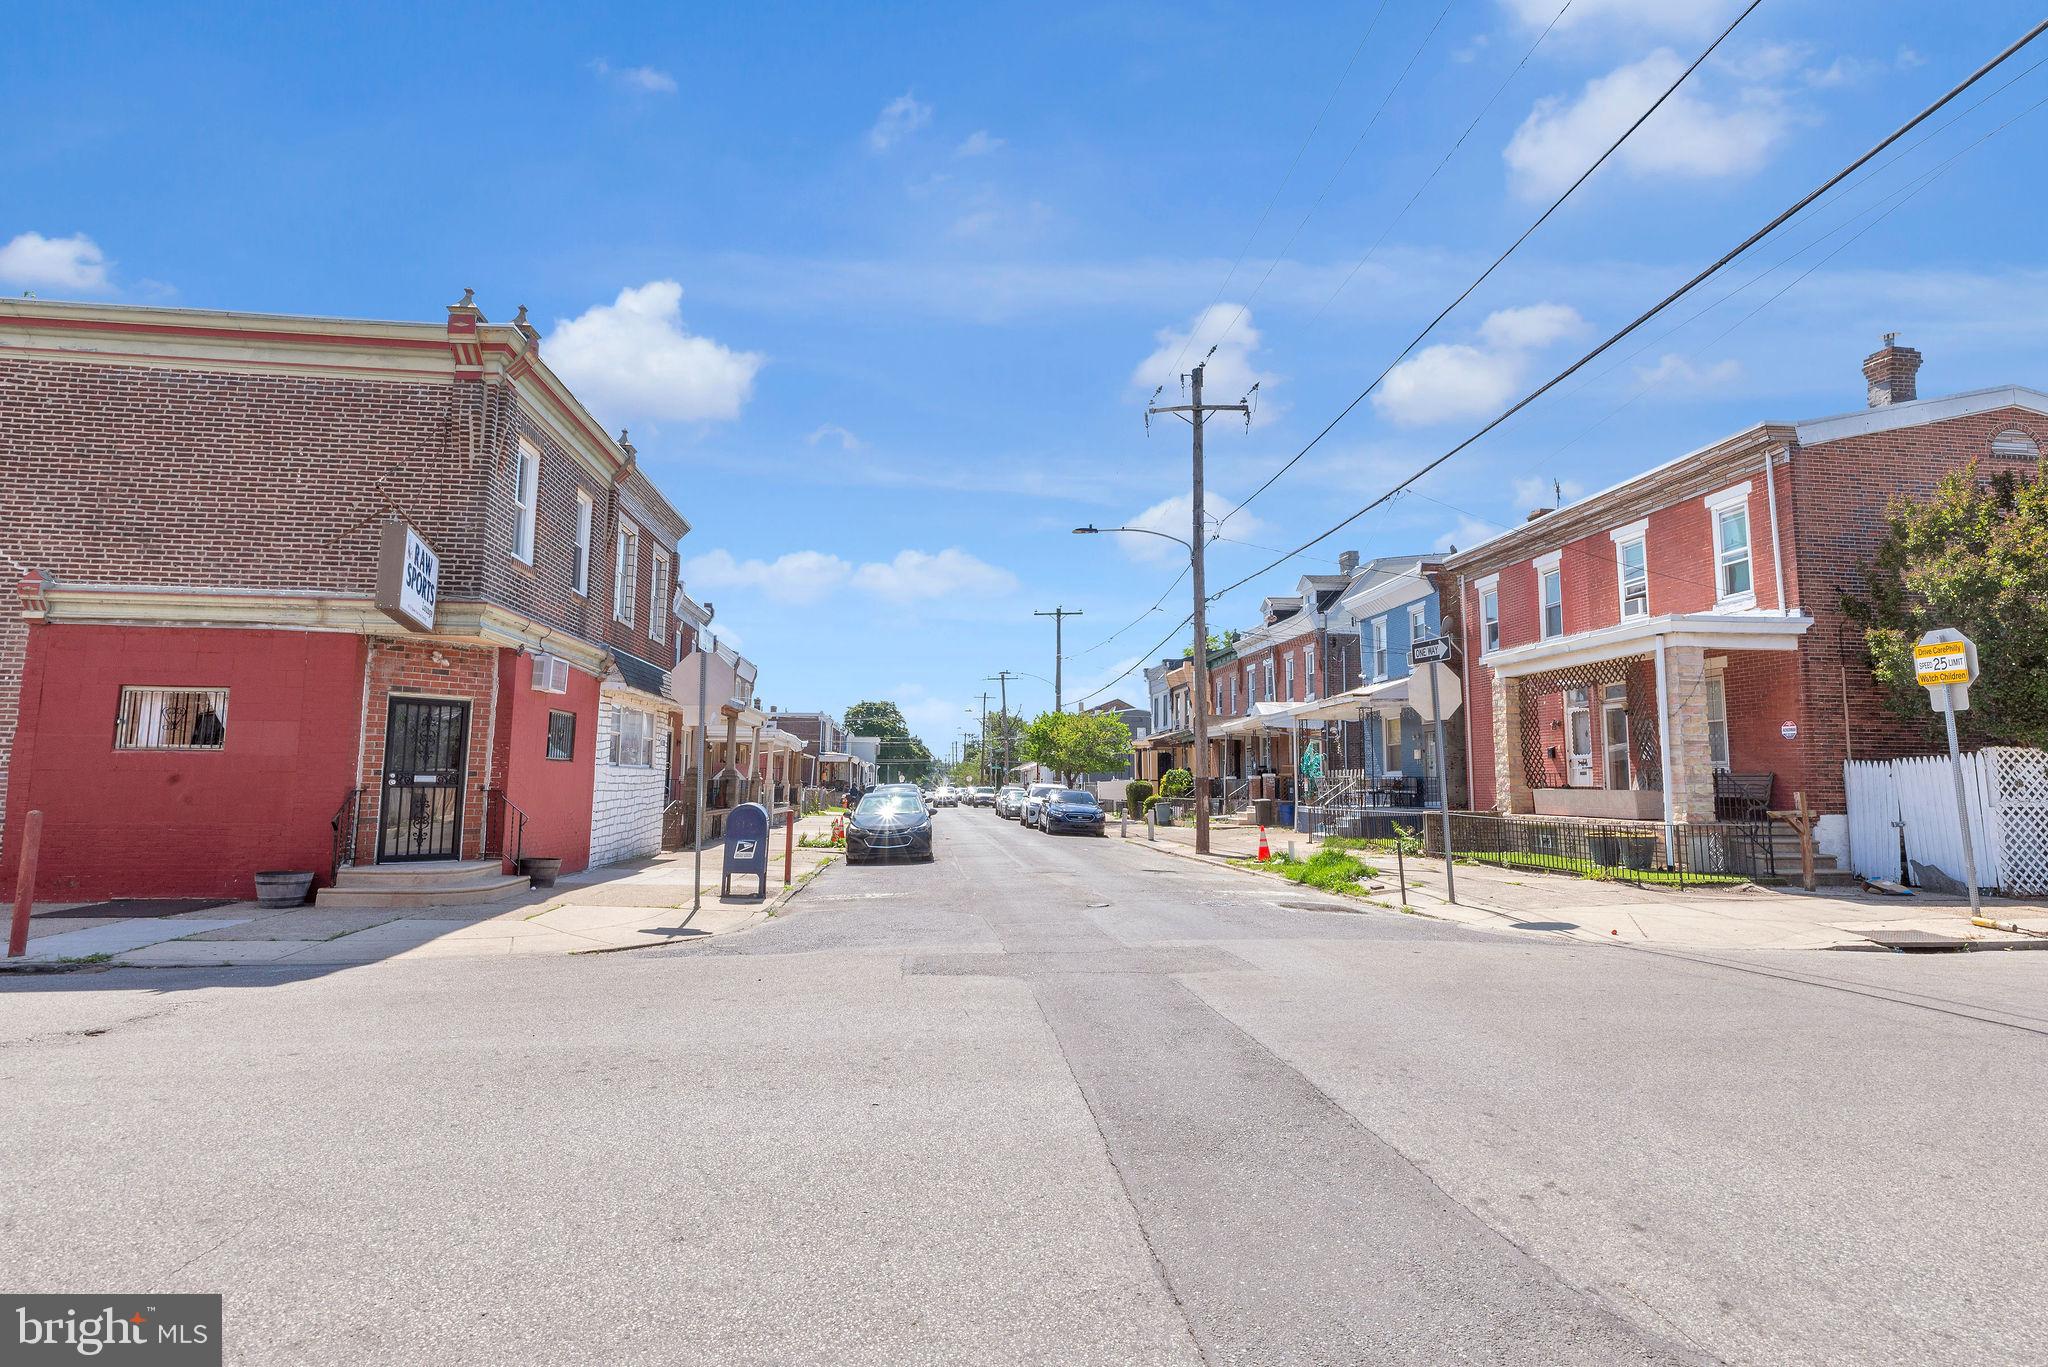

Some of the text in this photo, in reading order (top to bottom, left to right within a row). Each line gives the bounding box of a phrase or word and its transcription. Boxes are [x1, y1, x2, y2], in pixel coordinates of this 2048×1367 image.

[414, 543, 433, 578] RAW
[406, 563, 434, 606] SPORTS
[1416, 646, 1438, 657] ONE WAY
[1933, 657, 1948, 670] 25
[1948, 658, 1963, 666] LIMIT
[1920, 672, 1966, 682] Watch Children
